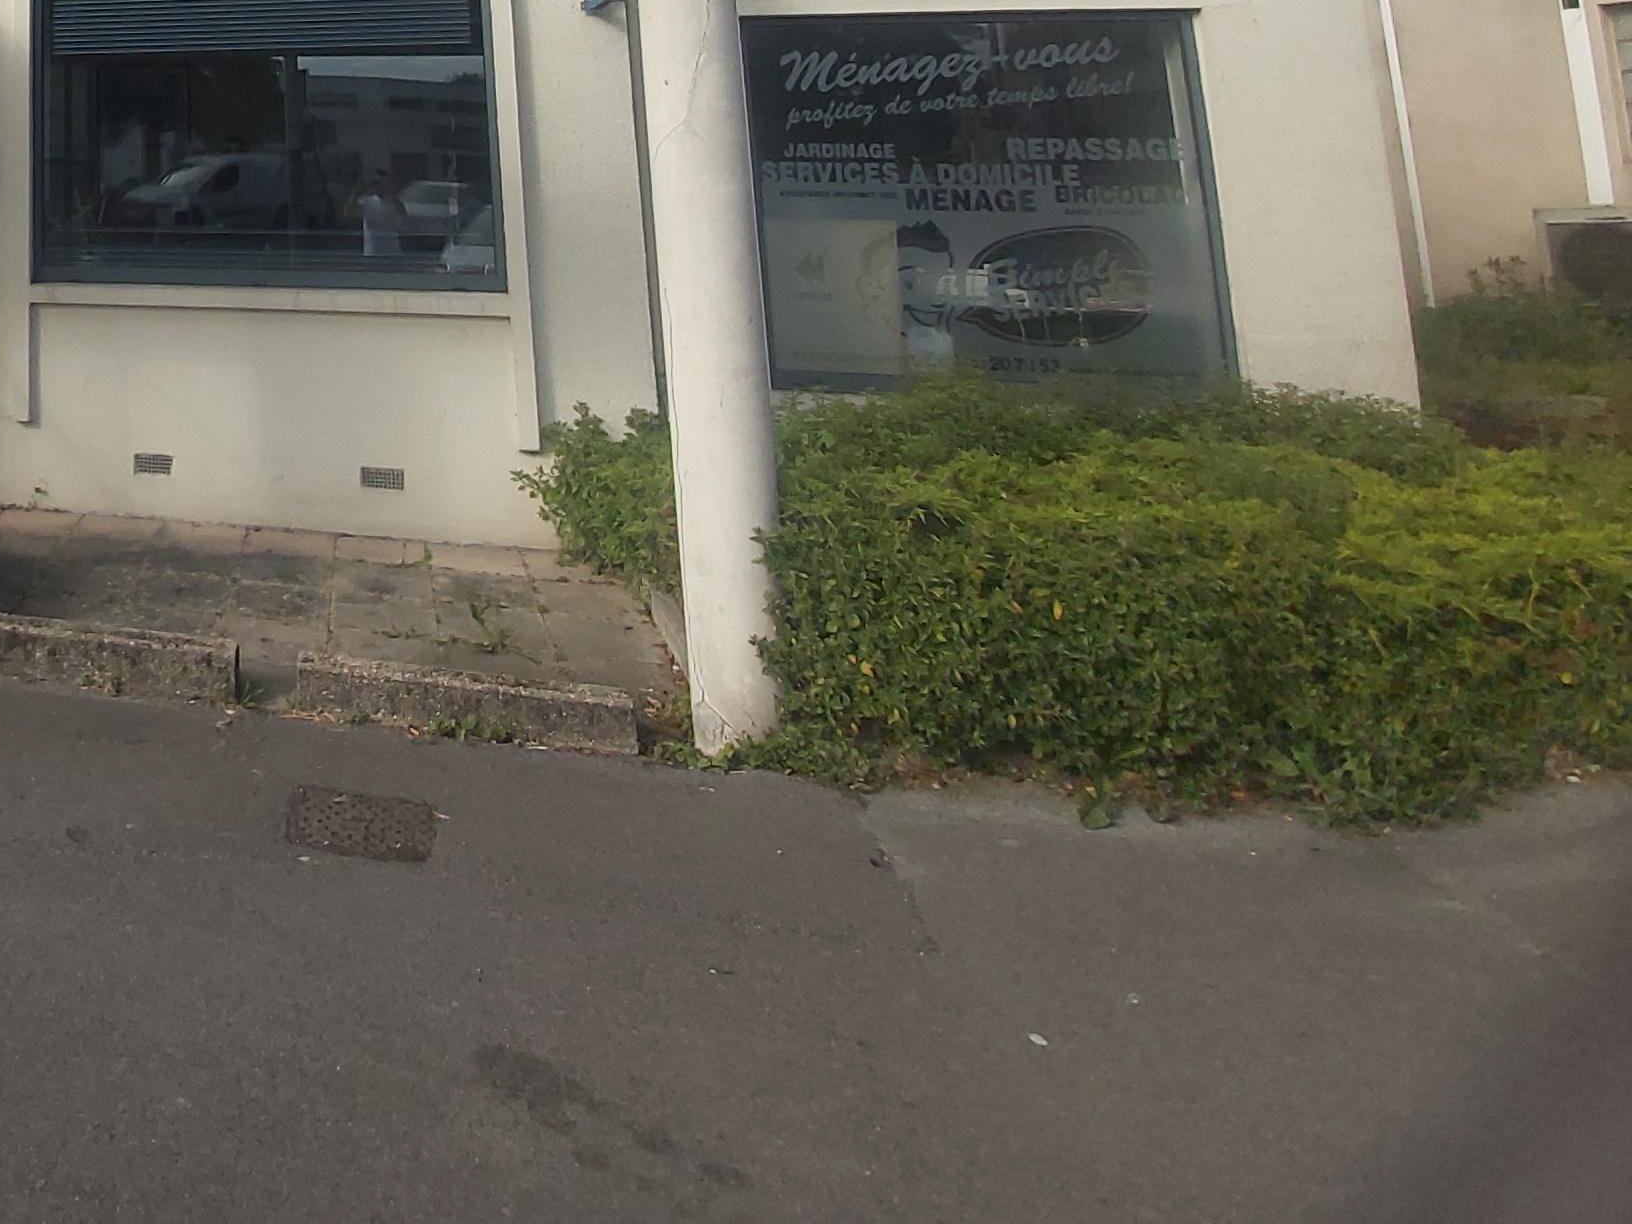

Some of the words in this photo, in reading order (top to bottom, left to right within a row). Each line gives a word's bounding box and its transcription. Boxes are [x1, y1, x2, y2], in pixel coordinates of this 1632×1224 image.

[787, 100, 878, 130] profitez
[885, 94, 912, 115] de
[920, 92, 977, 112] votre
[988, 84, 1058, 108] temps
[783, 143, 896, 158] JARDINAGE
[1006, 137, 1184, 161] REPASSAGE
[761, 162, 898, 184] SERVICES
[908, 156, 930, 185] À
[936, 162, 1082, 187] DOMICILE
